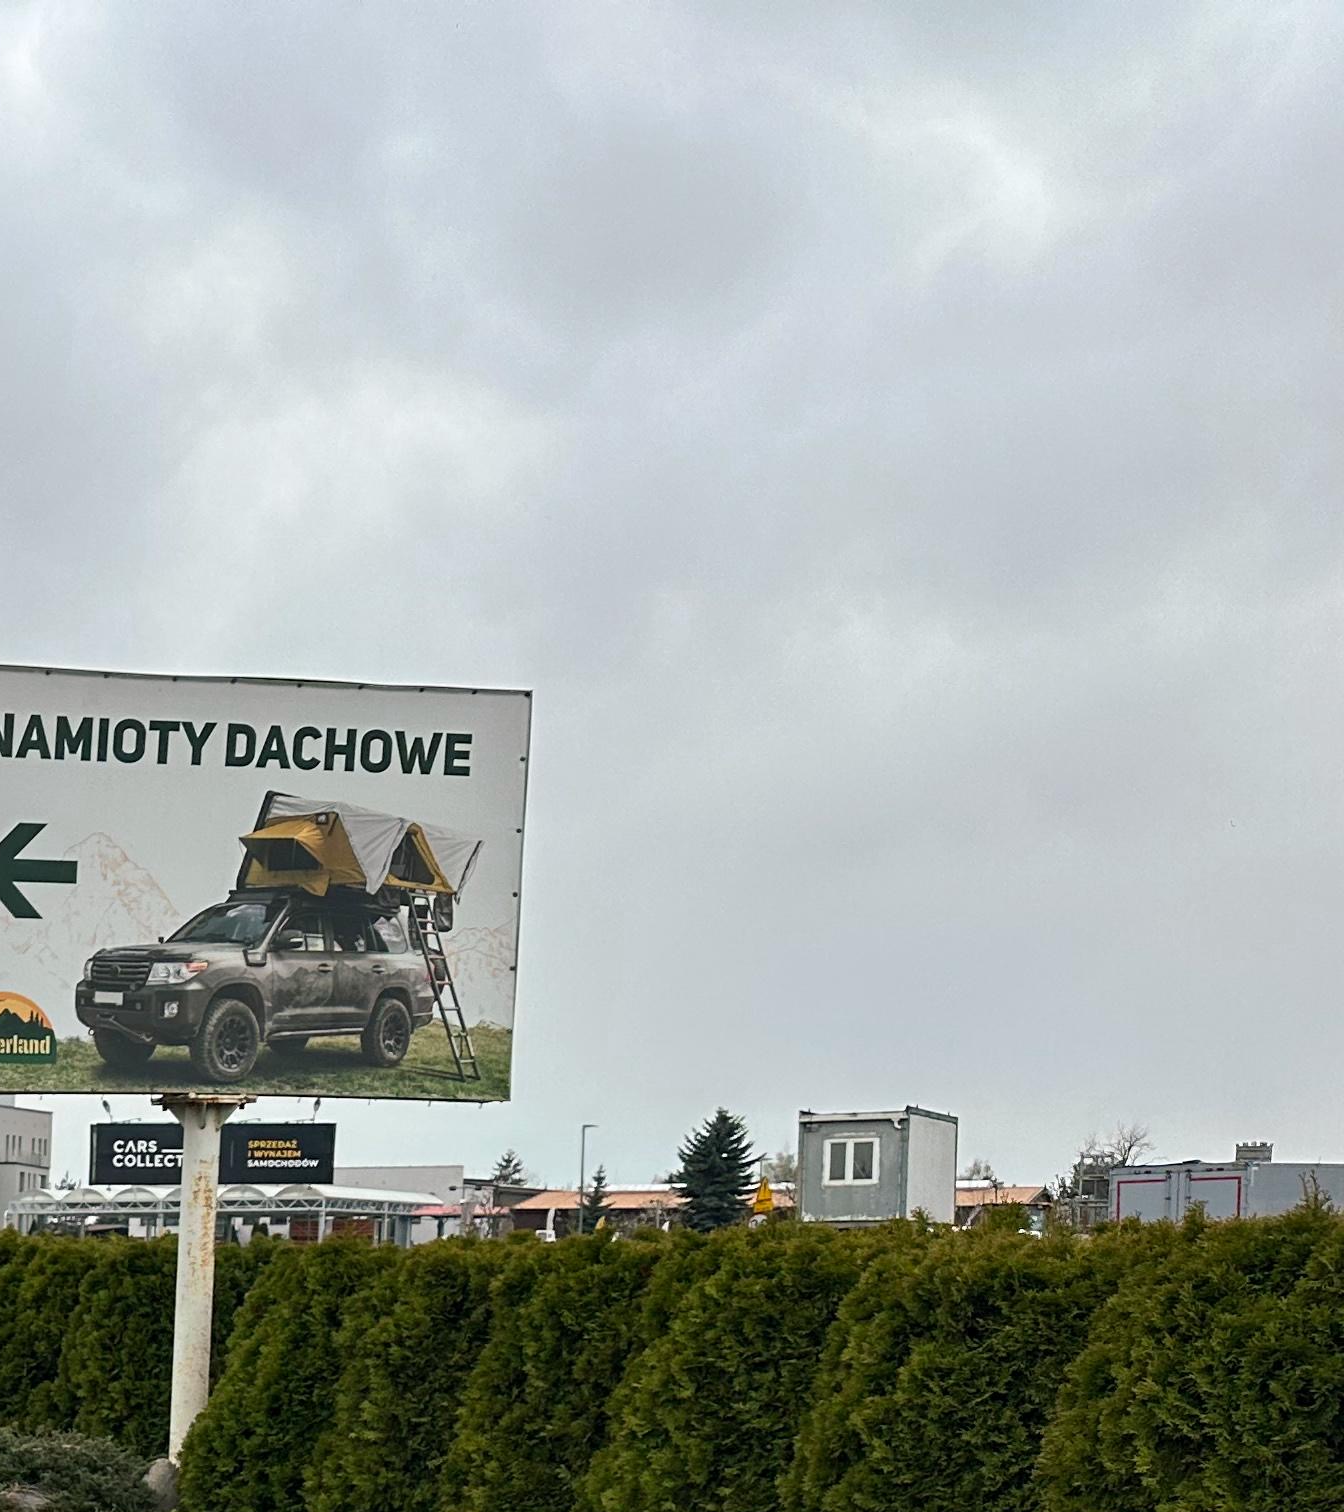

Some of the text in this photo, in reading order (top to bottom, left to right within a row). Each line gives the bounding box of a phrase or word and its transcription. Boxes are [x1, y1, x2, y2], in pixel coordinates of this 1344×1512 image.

[224, 722, 473, 777] DACHOWE
[112, 1139, 158, 1154] CARS
[247, 1139, 298, 1149] SPRZEDAŻ
[254, 1150, 302, 1158] WYNAJEM
[247, 1158, 320, 1168] SAMOCHODÓW
